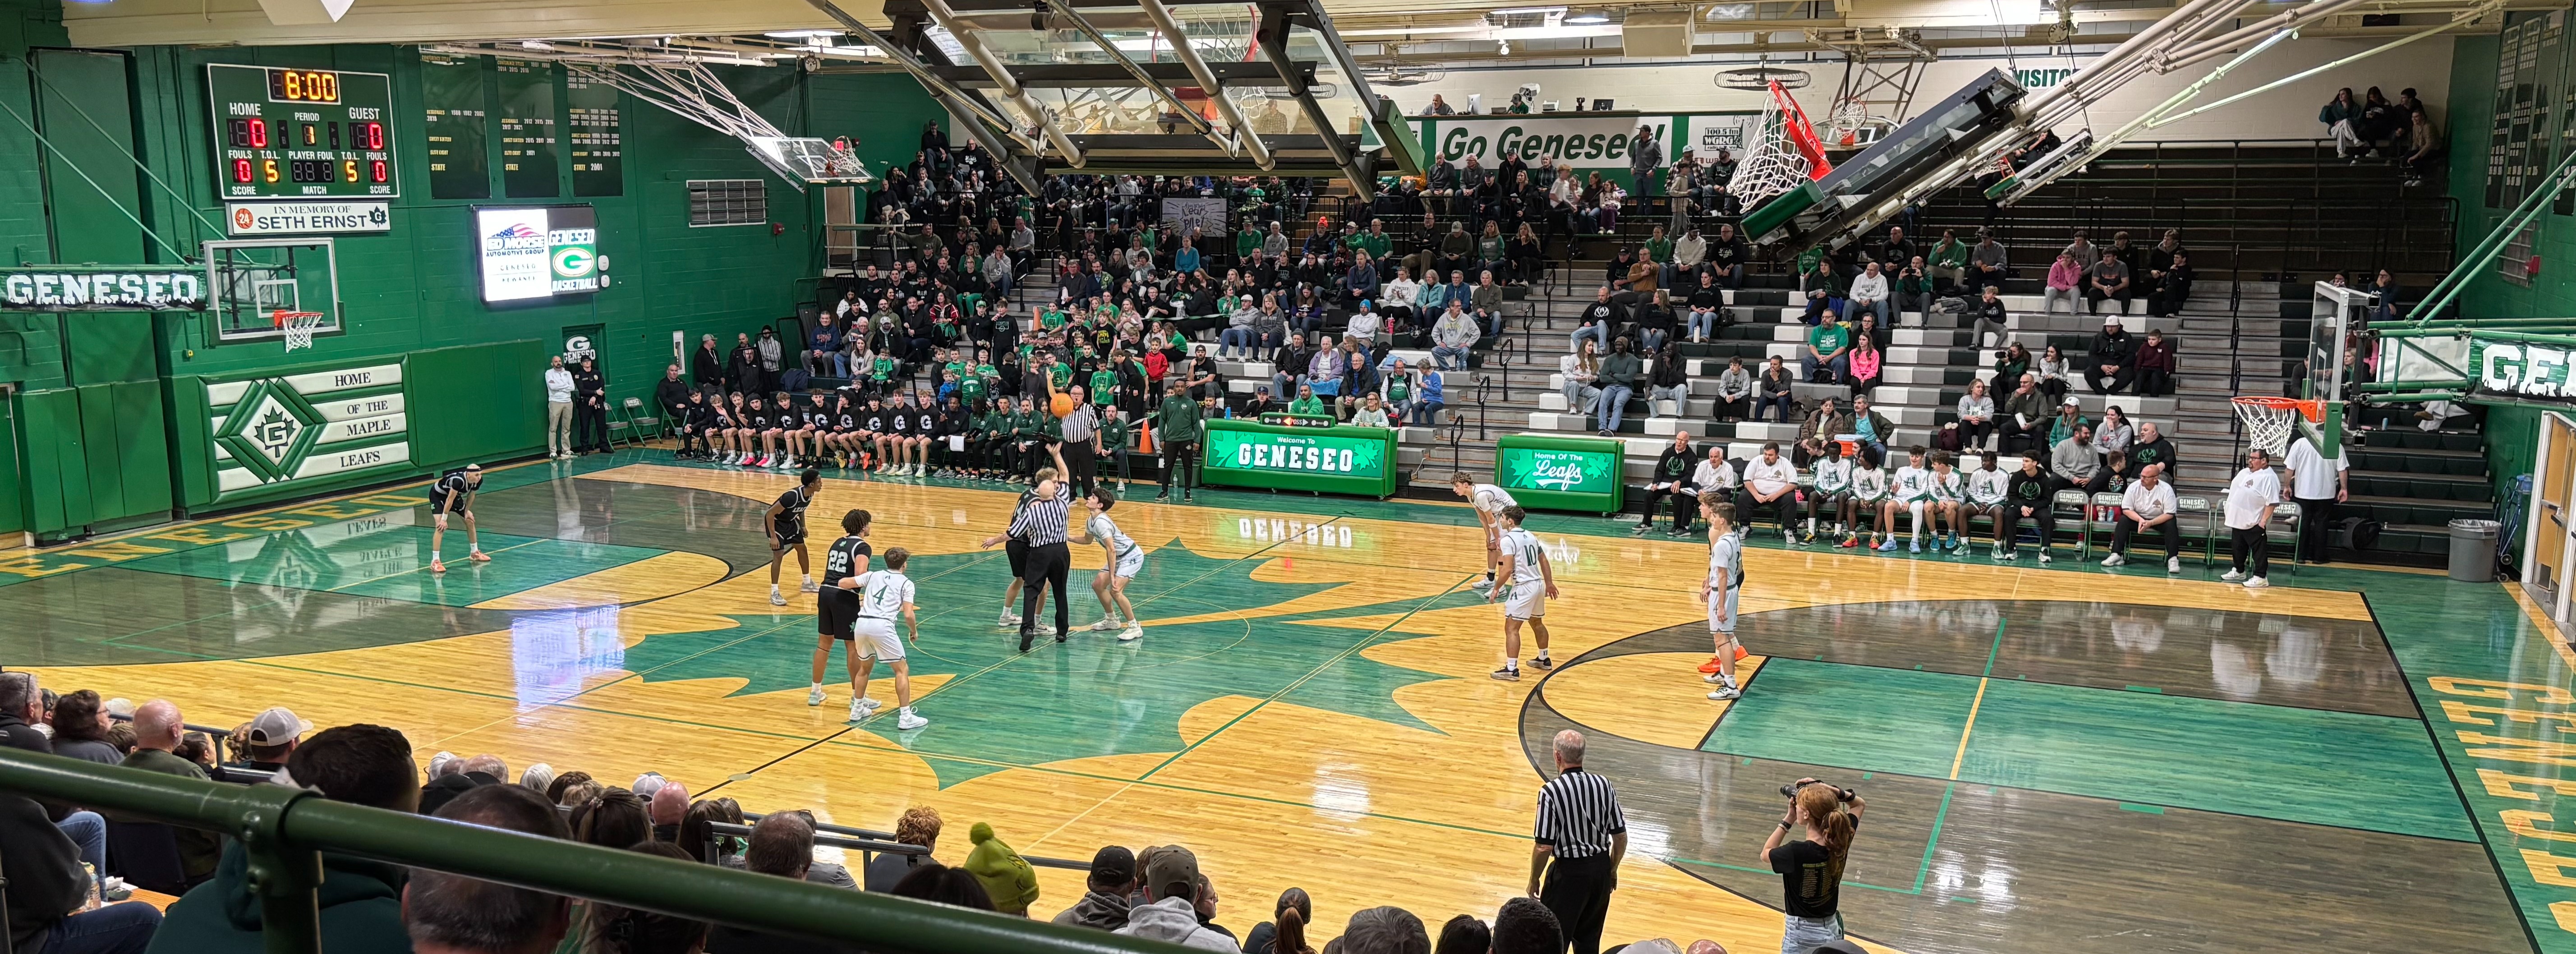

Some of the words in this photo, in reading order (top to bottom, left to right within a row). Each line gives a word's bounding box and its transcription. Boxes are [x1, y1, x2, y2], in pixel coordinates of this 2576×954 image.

[285, 71, 336, 101] 8:00
[2017, 69, 2081, 87] VISITO
[230, 102, 262, 116] HOME
[294, 112, 319, 122] PERIOD
[349, 107, 380, 120] GUEST
[249, 119, 267, 148] 0
[309, 126, 315, 144] 1
[368, 123, 383, 149] 0
[1443, 127, 1487, 161] Go
[1496, 123, 1665, 161] Genese!
[228, 150, 252, 159] FOULS
[260, 151, 281, 160] T.O.L.
[289, 151, 315, 160] PLAYER
[317, 152, 335, 161] FOUL
[341, 152, 360, 160] T.O.L.
[366, 152, 387, 161] FOULS
[238, 161, 252, 181] 0
[265, 161, 279, 182] 5
[345, 161, 358, 182] 5
[375, 162, 386, 181] 0
[590, 163, 603, 171] 2001
[232, 186, 256, 195] SCORE
[303, 186, 327, 195] MATCH
[370, 185, 391, 194] SCORE
[289, 205, 335, 214] MEMORY
[337, 205, 351, 213] OF
[239, 212, 250, 225] 24
[258, 217, 305, 230] SETH
[311, 215, 367, 228] ERNST
[487, 238, 504, 250] ED
[548, 229, 595, 246] GENESEO
[6, 274, 198, 305] GENESEO
[552, 278, 598, 292] BASKETBALL
[566, 336, 590, 352] G
[2481, 343, 2576, 397] GE
[335, 372, 372, 387] HOME
[347, 404, 361, 415] OF
[366, 400, 388, 412] THE
[263, 422, 288, 446] G
[346, 419, 391, 437] MAPLE
[1277, 436, 1306, 444] Welcome
[340, 451, 381, 467] LEAFS
[1238, 443, 1353, 472] GENESEO
[1532, 459, 1583, 491] Leafs
[828, 550, 848, 573] 22
[1524, 544, 1537, 567] 10
[873, 585, 888, 606] 4
